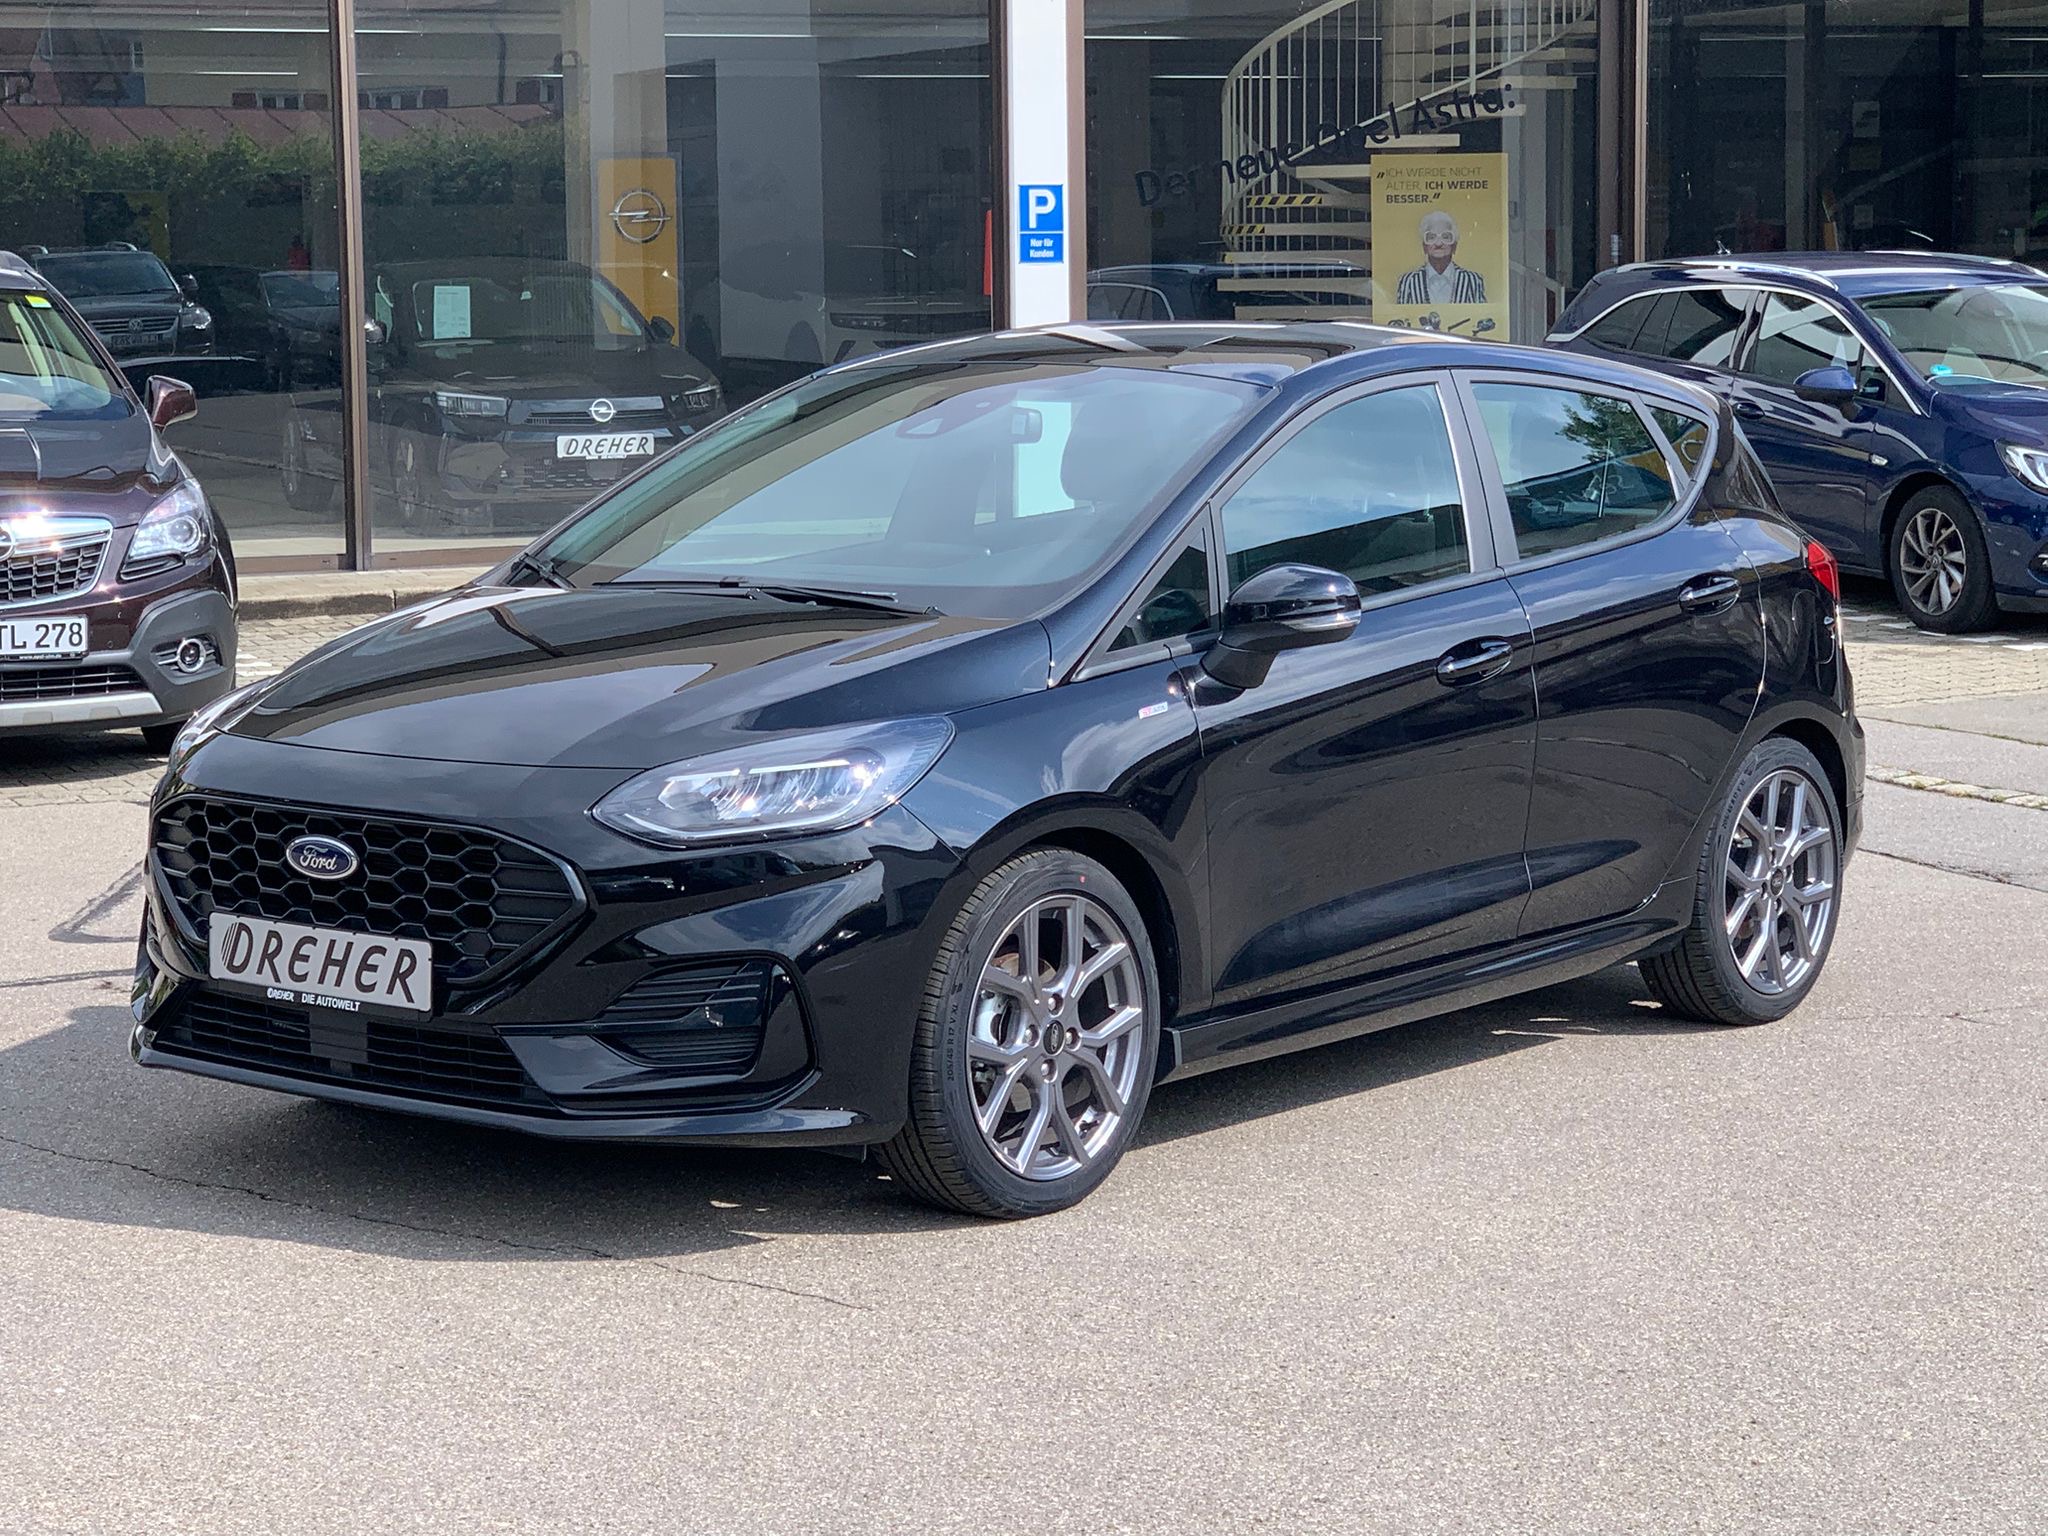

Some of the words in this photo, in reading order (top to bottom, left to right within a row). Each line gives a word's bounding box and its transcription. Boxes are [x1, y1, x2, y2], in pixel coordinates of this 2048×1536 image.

[1135, 167, 1200, 207] Der
[1214, 142, 1301, 186] neue
[1406, 167, 1447, 177] WERDE
[1449, 166, 1482, 176] NICHT
[1425, 181, 1443, 190] ICH
[1447, 180, 1488, 189] WERDE
[1029, 189, 1056, 228] P
[1030, 238, 1042, 247] Nur
[1043, 238, 1053, 247] für
[1030, 249, 1054, 258] Kunden
[564, 437, 649, 456] DREHER
[35, 622, 83, 648] 278
[300, 844, 338, 871] Ford
[221, 921, 418, 1004] DREHER
[266, 987, 295, 1003] DREHER
[302, 993, 315, 1005] DIE
[316, 996, 361, 1012] AUTOWELT
